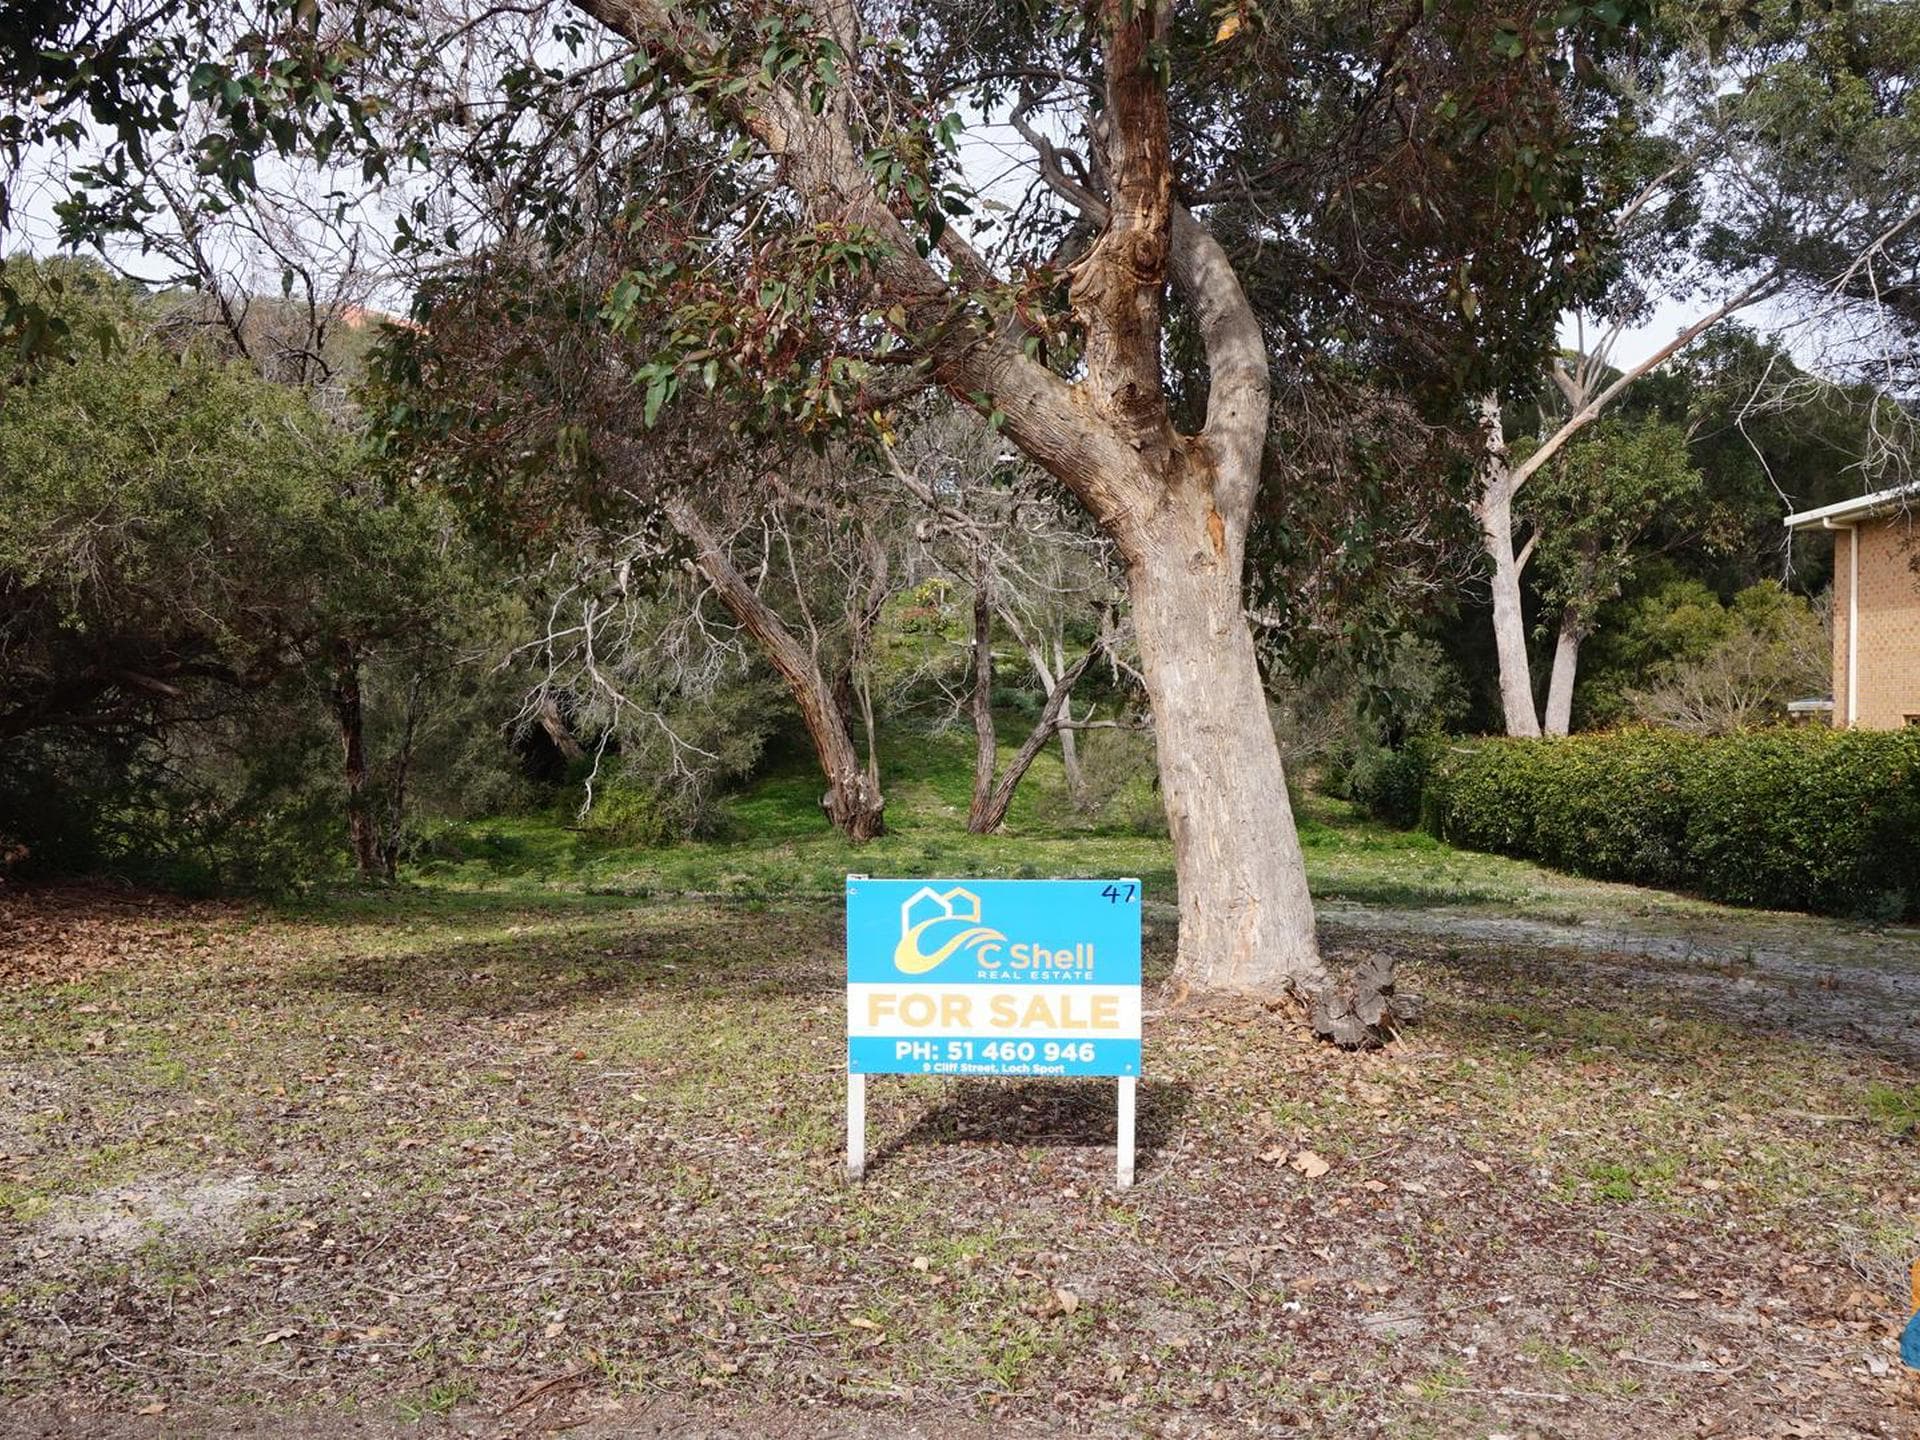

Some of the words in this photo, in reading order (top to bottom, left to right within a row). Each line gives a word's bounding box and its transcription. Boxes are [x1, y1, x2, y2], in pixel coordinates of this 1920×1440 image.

[1101, 884, 1136, 904] 47
[977, 943, 1002, 969] C
[1009, 943, 1094, 969] Shell
[977, 970, 1021, 980] REAL
[1030, 971, 1093, 980] ESTATE
[867, 993, 972, 1028] FOR
[990, 993, 1120, 1030] SALE
[895, 1040, 939, 1060] PH:
[948, 1041, 973, 1060] 51
[981, 1041, 1036, 1061] 460
[1043, 1042, 1096, 1062] 946
[923, 1062, 931, 1072] 9
[933, 1062, 958, 1072] Cliff
[960, 1063, 999, 1073] Street,
[1001, 1063, 1030, 1073] Loch
[1032, 1063, 1065, 1075] Sport
